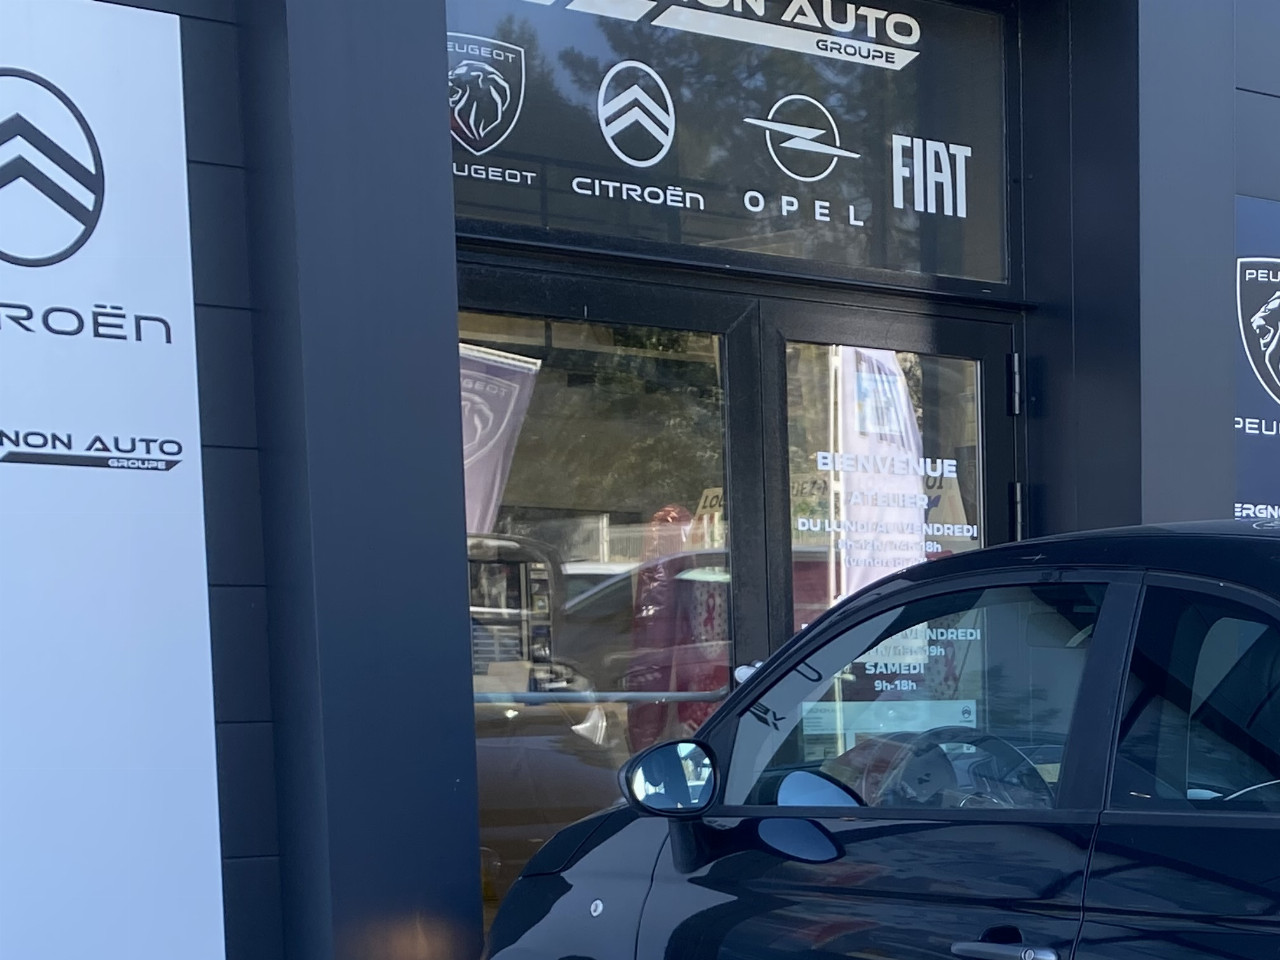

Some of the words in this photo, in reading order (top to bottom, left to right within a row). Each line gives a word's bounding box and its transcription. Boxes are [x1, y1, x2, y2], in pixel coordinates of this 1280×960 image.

[780, 0, 921, 45] AUTO
[816, 39, 896, 64] GROUPE
[892, 134, 972, 218] FIAT
[743, 190, 865, 227] OPEL
[85, 435, 183, 456] AUTO
[107, 458, 166, 469] GROUPE
[816, 451, 958, 478] BIENVENUE
[850, 492, 929, 509] ATELIER
[797, 518, 821, 532] DU
[825, 518, 872, 532] LUNDI
[900, 521, 978, 538] VENDREDI
[865, 662, 925, 674] SAMEDI
[874, 680, 917, 691] 9h-18h
